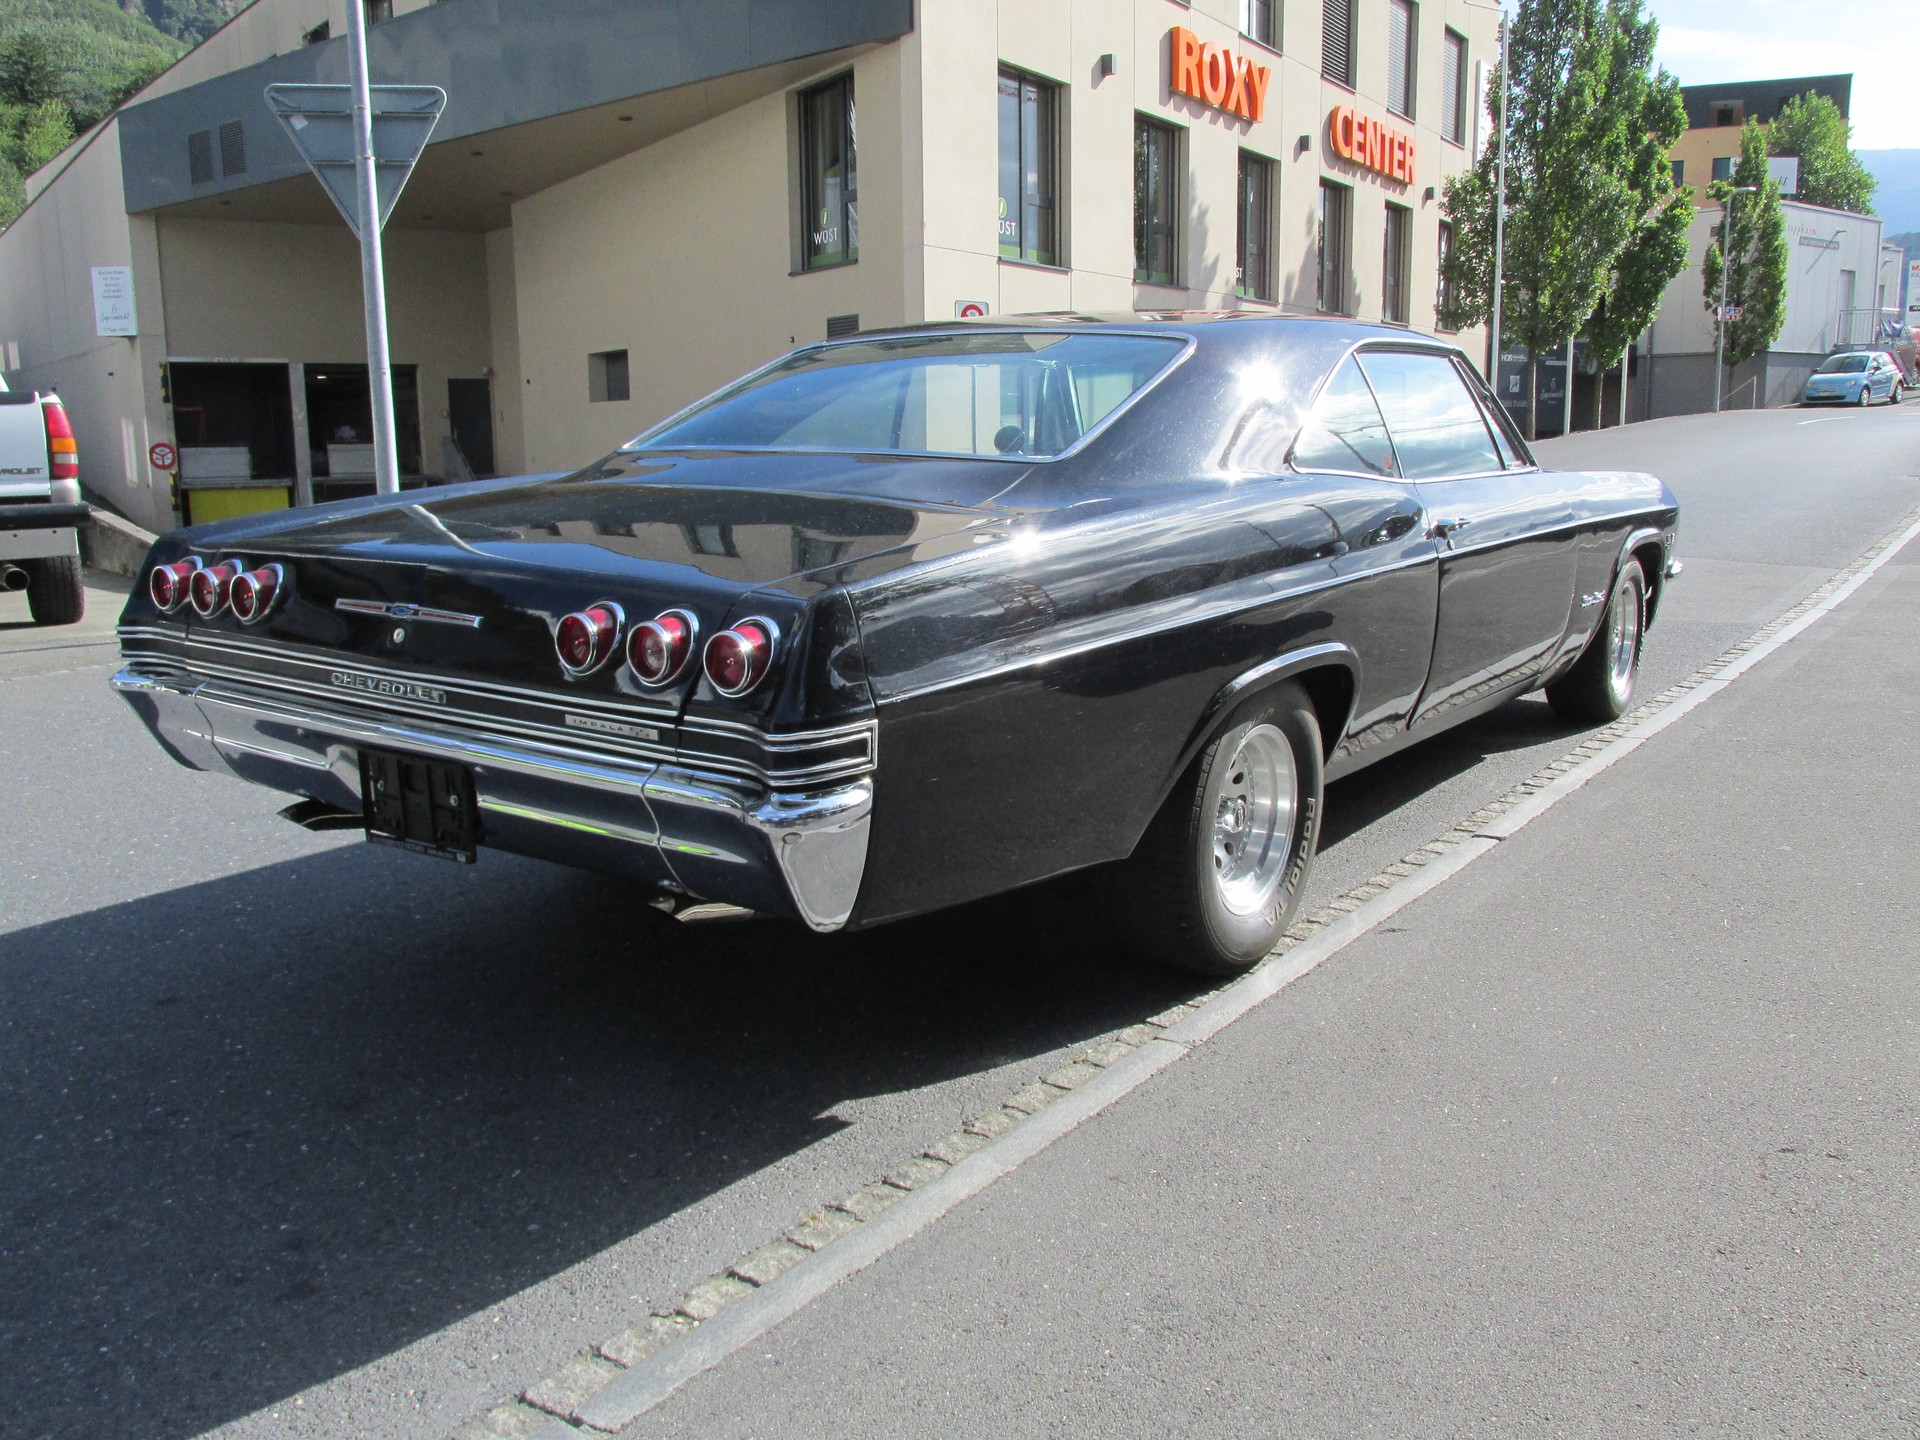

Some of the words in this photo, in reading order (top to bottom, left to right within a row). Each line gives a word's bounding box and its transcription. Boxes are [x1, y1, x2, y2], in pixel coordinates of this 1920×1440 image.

[1170, 26, 1270, 123] ROXY
[1330, 104, 1417, 186] CENTER
[998, 220, 1016, 237] ÜST
[331, 672, 447, 704] CHEVROLET
[573, 719, 624, 731] IMPALA
[1286, 798, 1316, 897] Radial
